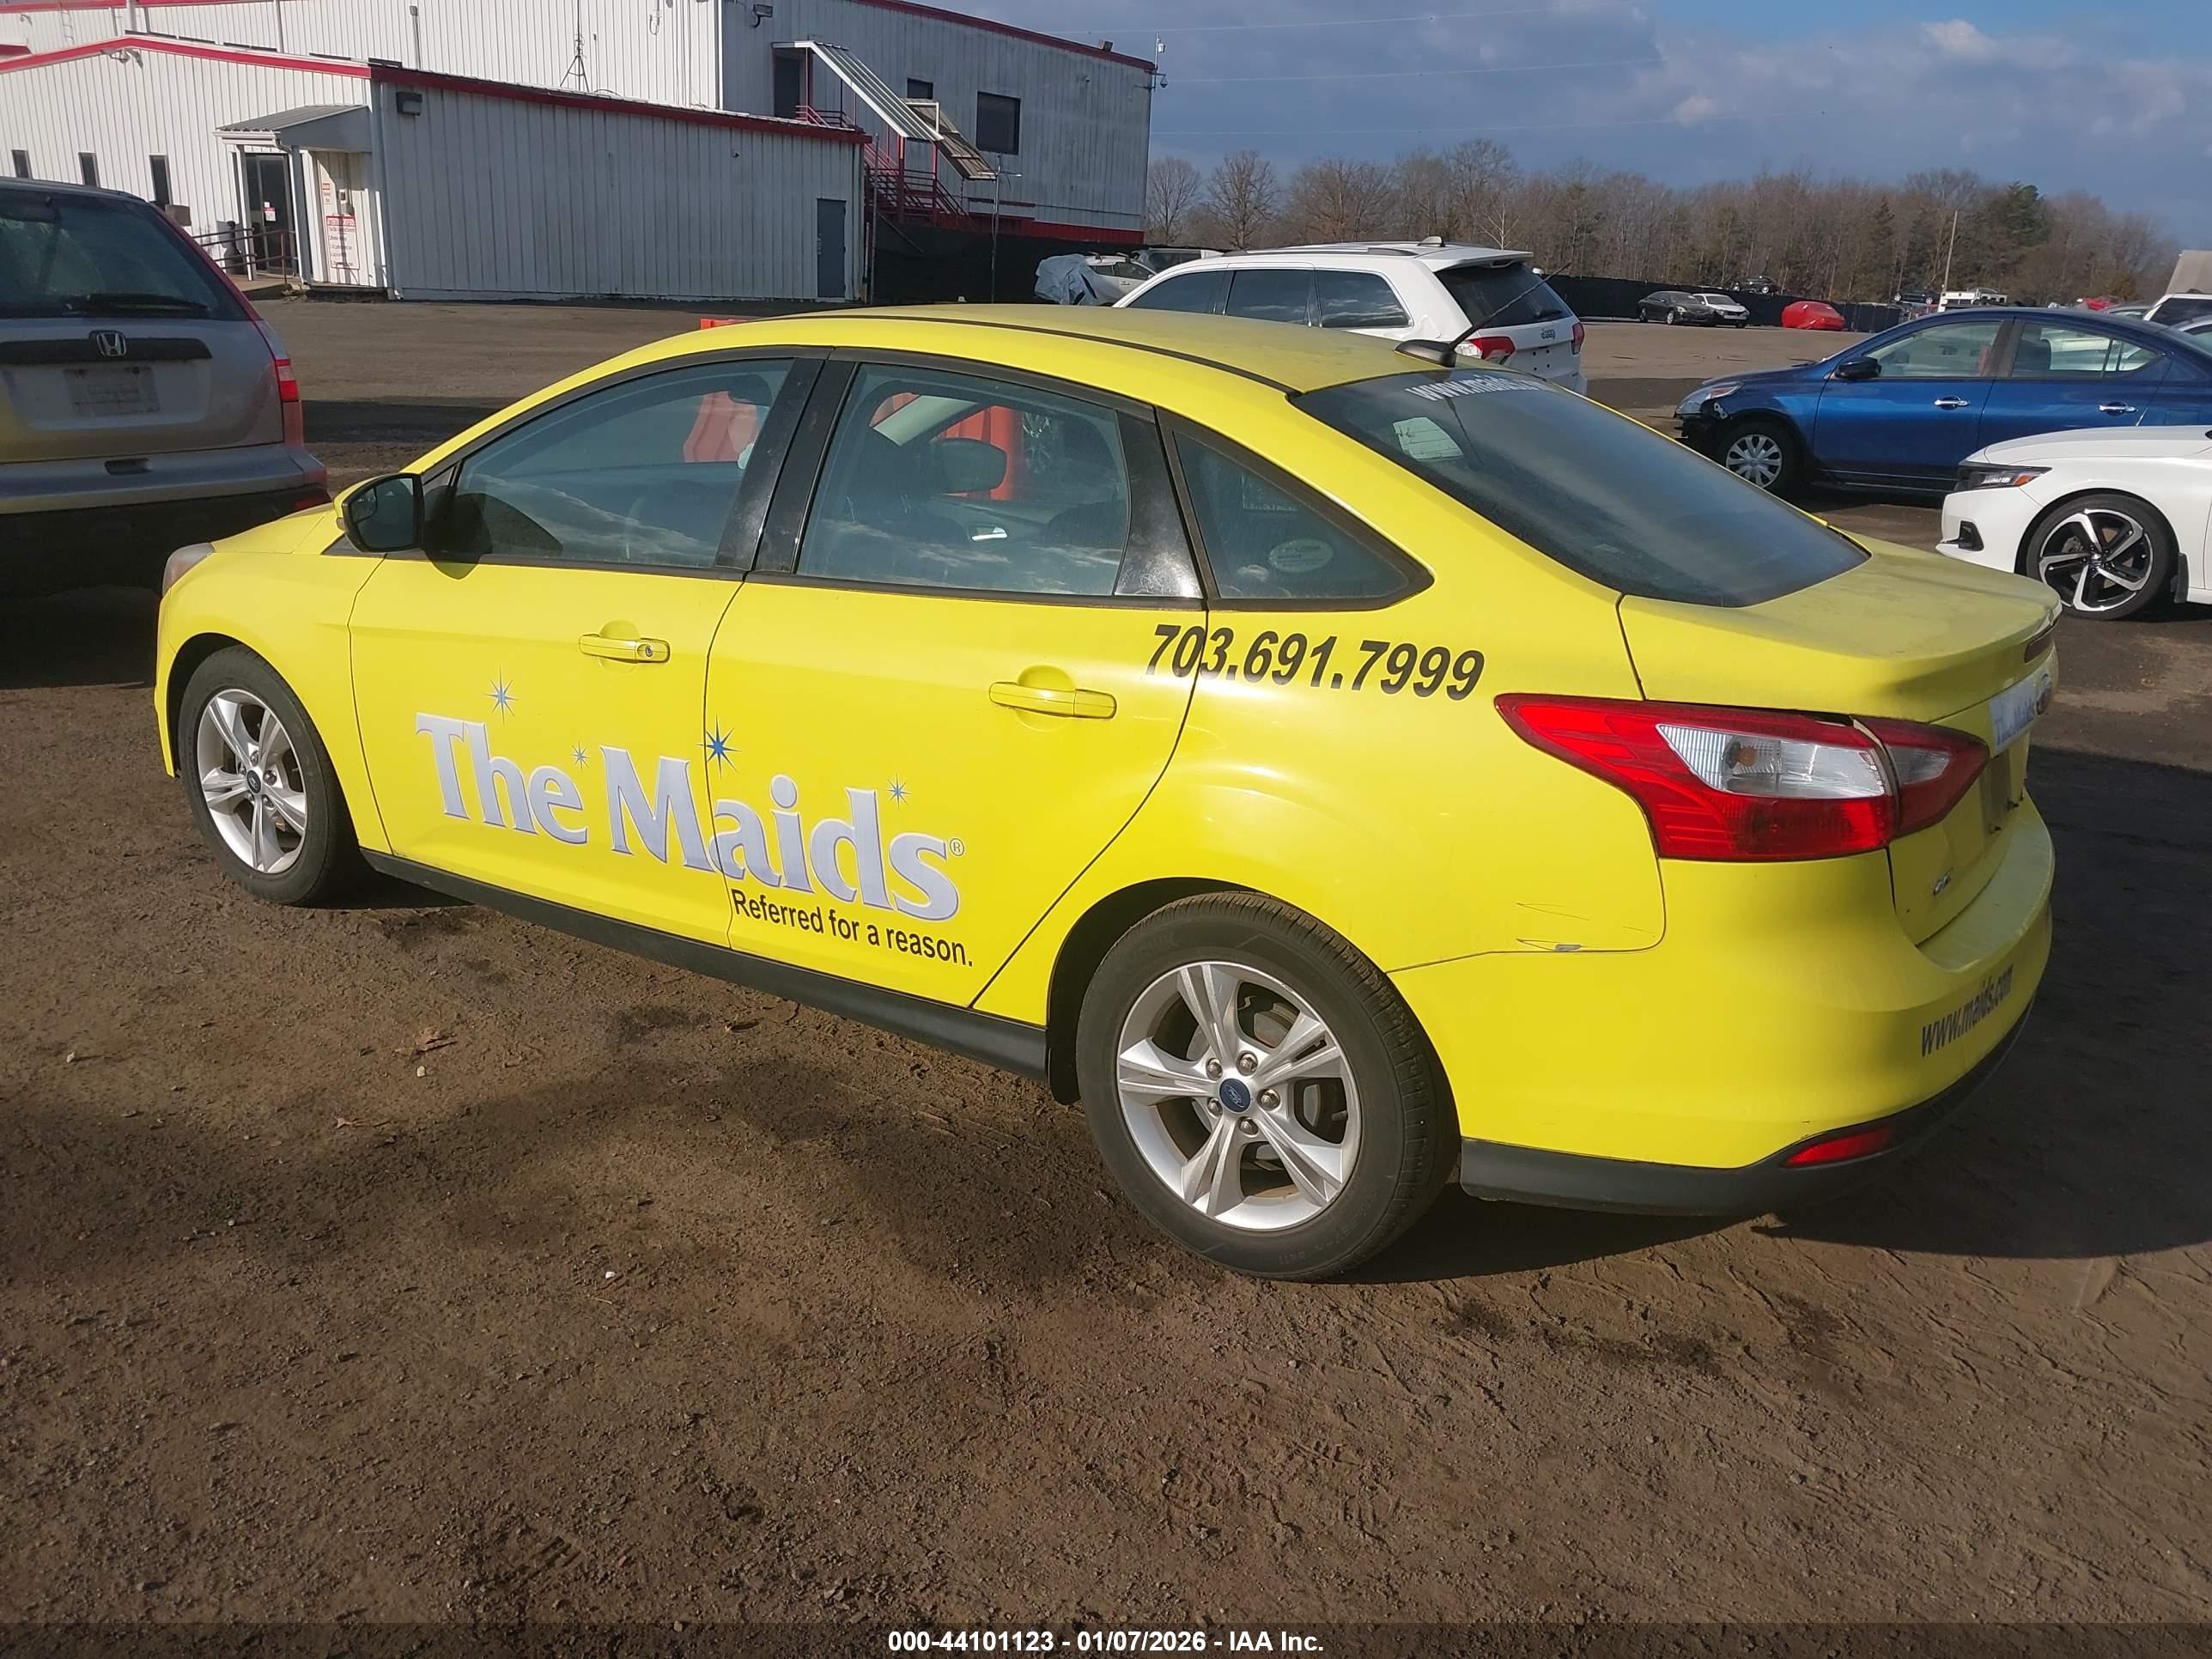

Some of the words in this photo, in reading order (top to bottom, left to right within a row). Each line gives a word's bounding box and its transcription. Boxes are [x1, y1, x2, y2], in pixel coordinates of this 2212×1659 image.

[1404, 374, 1540, 402] www.maids.
[1146, 623, 1486, 702] 703.691.7999
[416, 712, 588, 845] The
[731, 888, 824, 934] Referred
[829, 908, 860, 941] for
[866, 923, 880, 946] a
[887, 927, 974, 968] reason.
